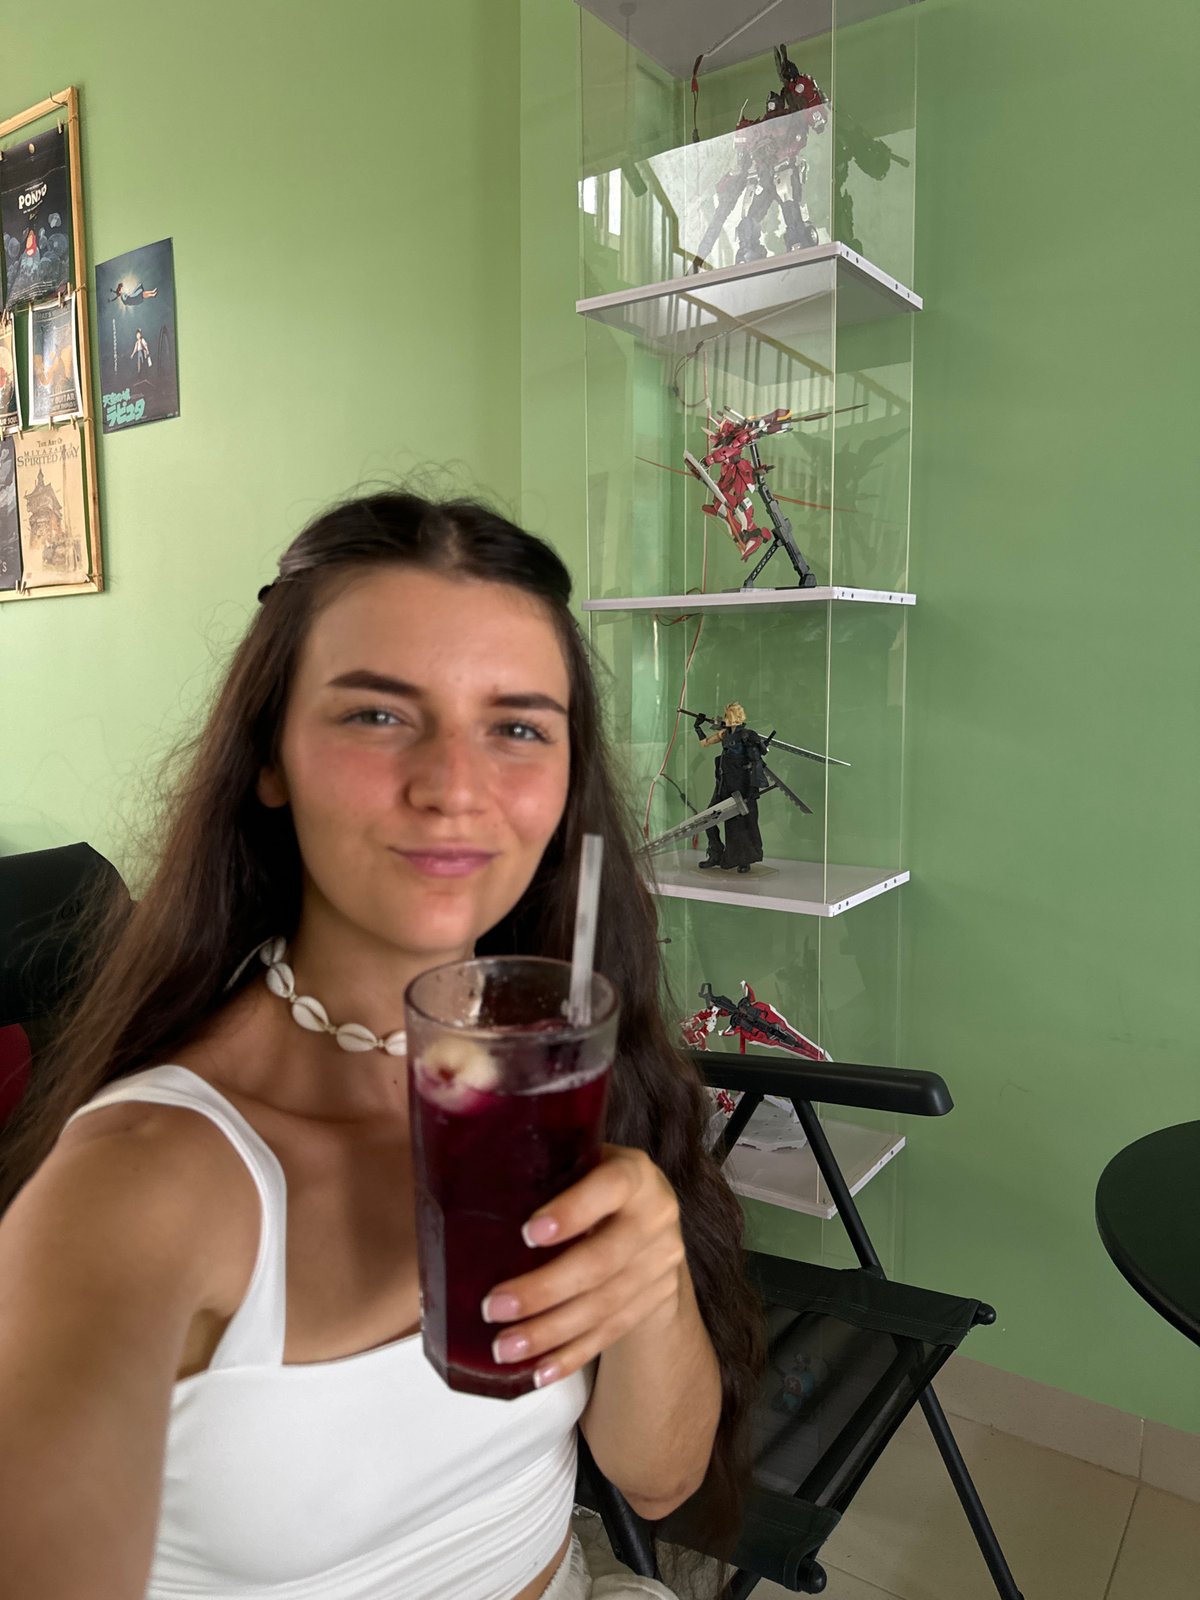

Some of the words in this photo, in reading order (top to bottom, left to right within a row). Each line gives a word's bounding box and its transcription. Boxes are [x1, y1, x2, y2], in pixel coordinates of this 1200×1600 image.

[18, 183, 47, 210] PONYO
[107, 398, 146, 427] ラピュタ
[17, 454, 58, 467] SPIRITED
